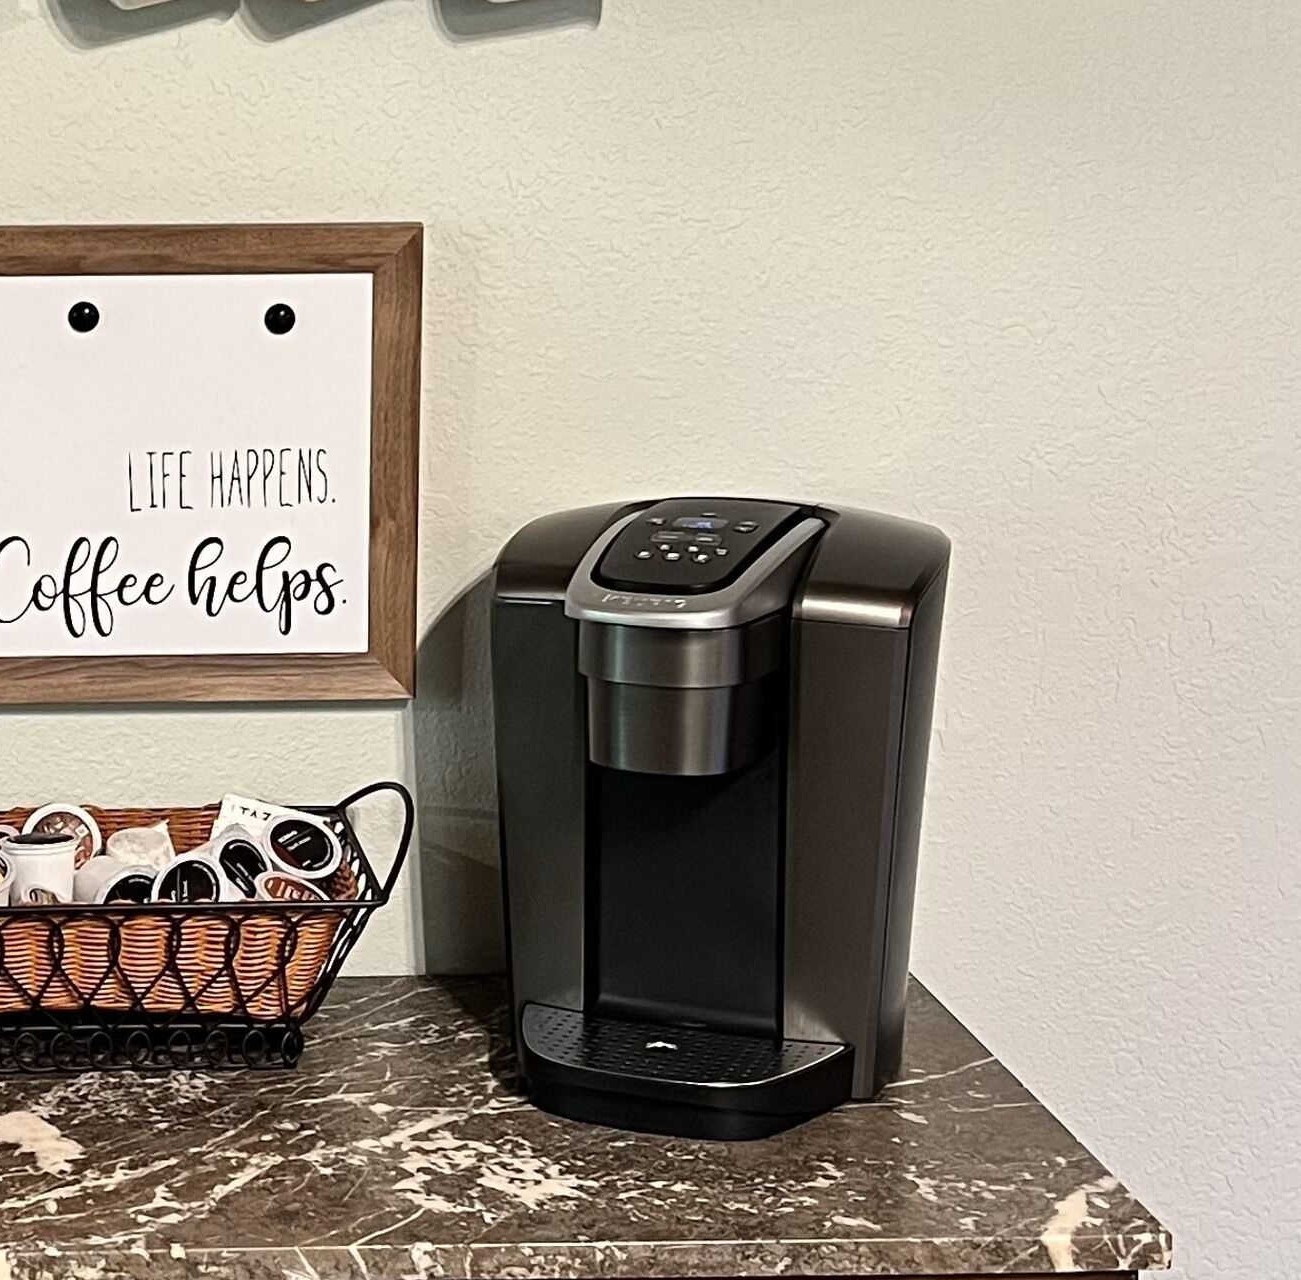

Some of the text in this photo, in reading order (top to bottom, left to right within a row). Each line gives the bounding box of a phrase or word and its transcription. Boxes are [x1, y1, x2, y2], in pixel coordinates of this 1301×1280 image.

[127, 448, 336, 513] LIFE HAPPENS.
[186, 535, 348, 636] helps.
